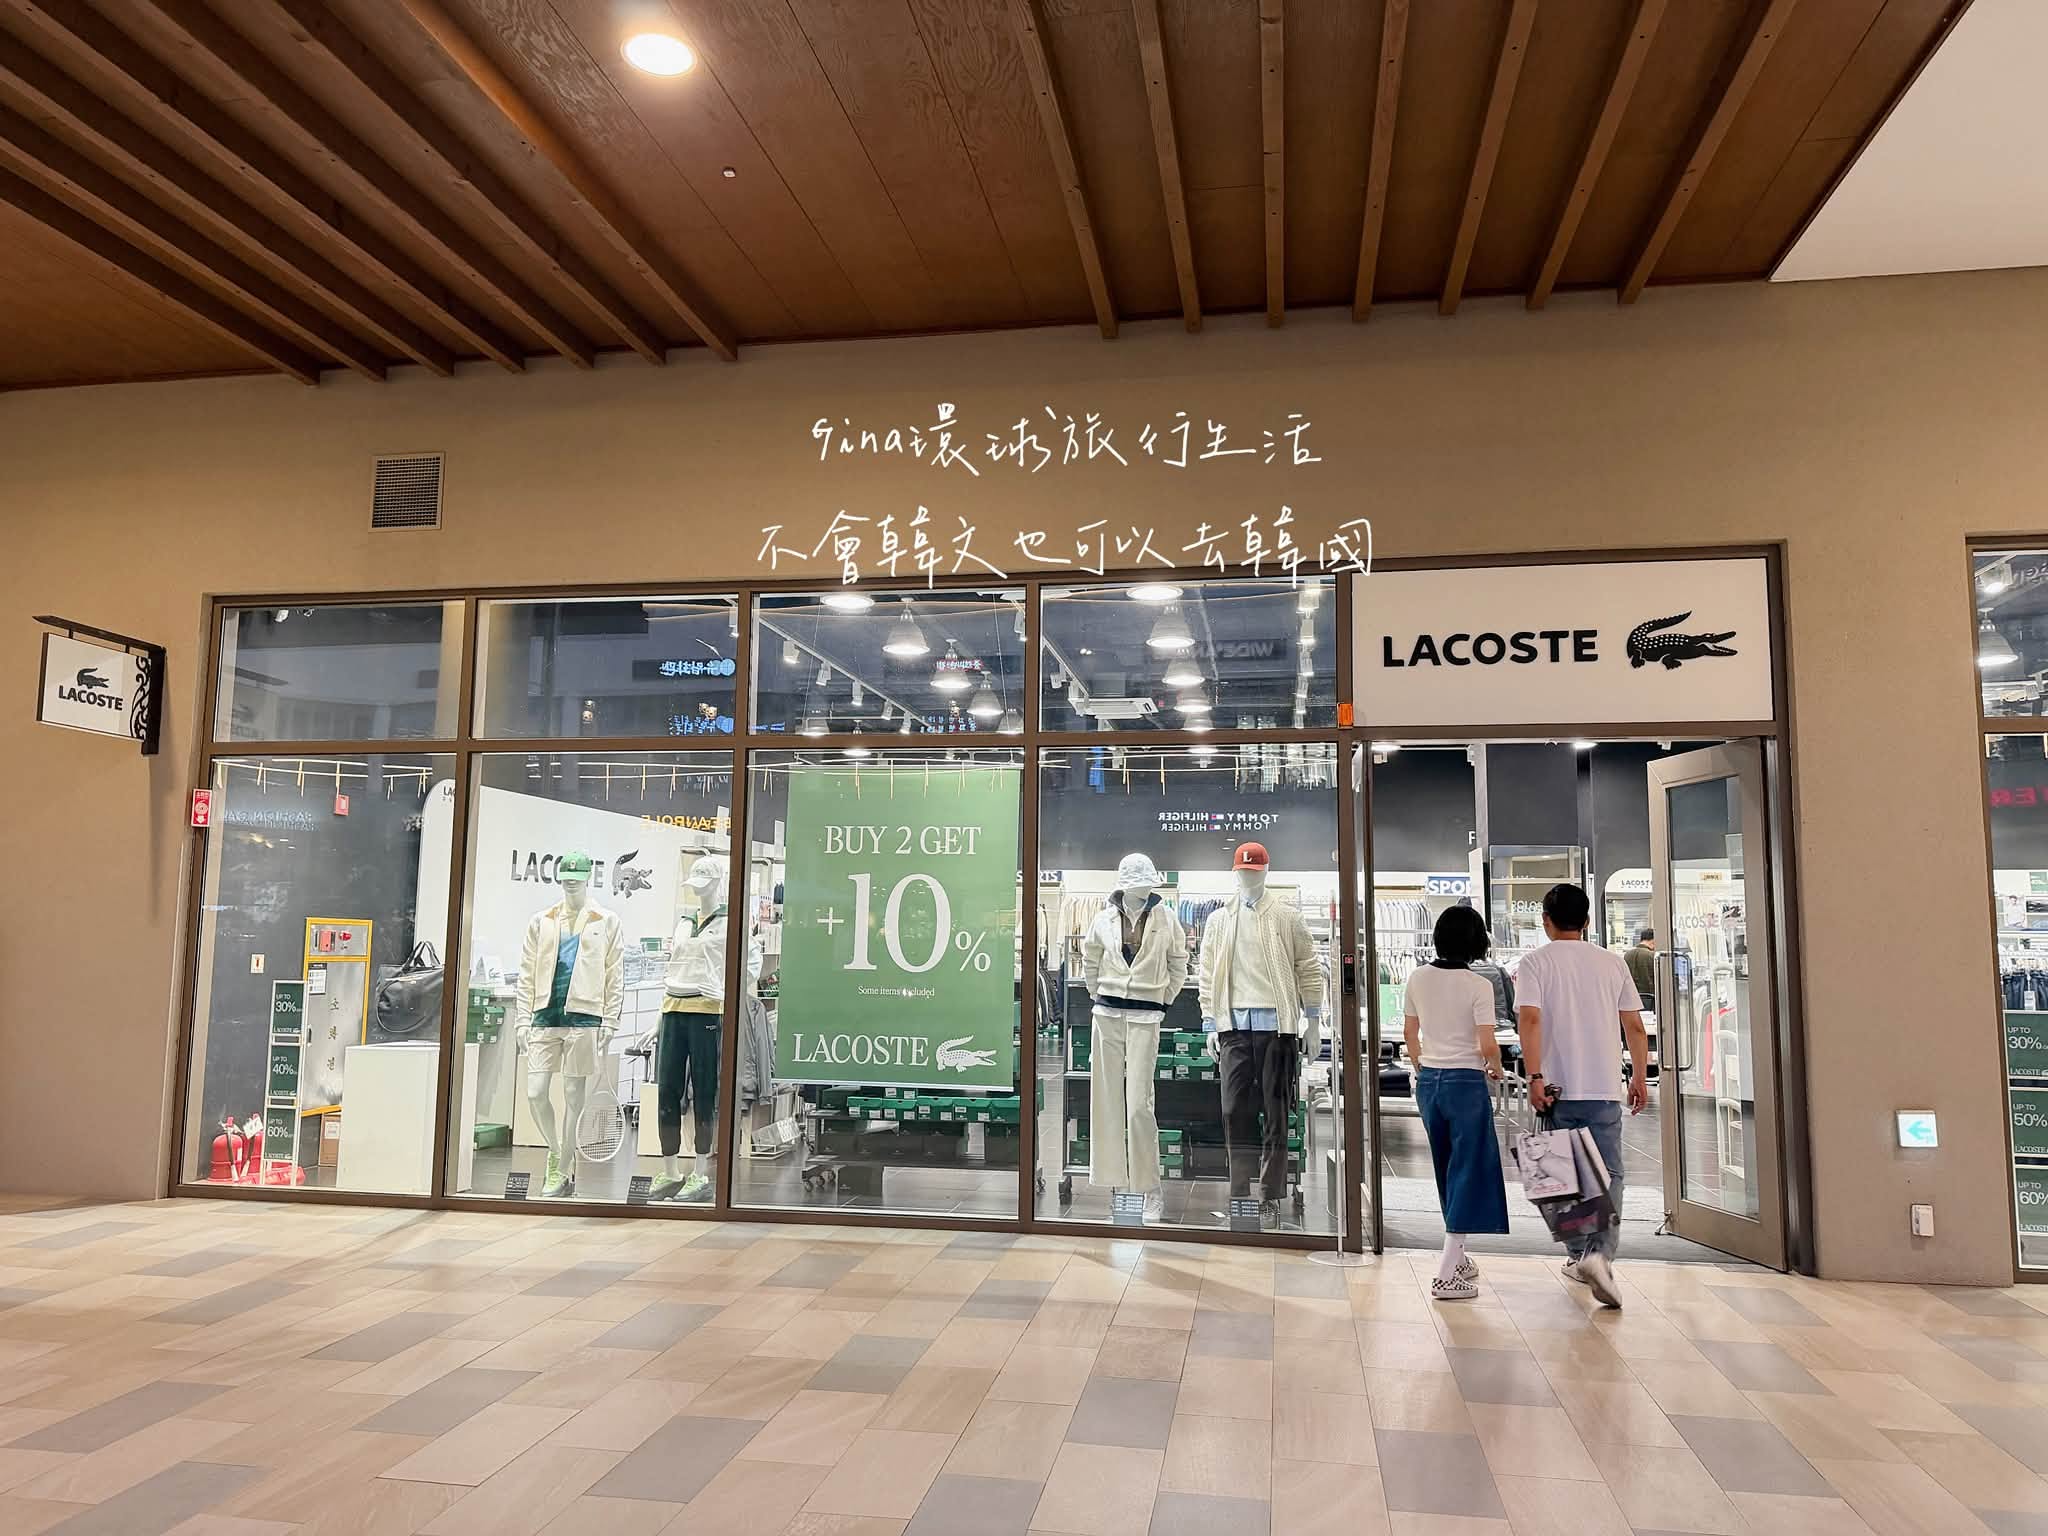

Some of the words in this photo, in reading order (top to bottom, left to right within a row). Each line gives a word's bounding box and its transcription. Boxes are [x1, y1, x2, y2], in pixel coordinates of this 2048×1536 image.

[1383, 629, 1599, 668] LACOSTE
[58, 685, 123, 711] LACOSTE
[824, 825, 888, 854] BUY
[896, 826, 912, 855] 2
[920, 827, 982, 855] GET
[1243, 851, 1252, 862] L
[858, 985, 879, 995] Some
[880, 986, 900, 996] items
[902, 987, 935, 998] cluded
[275, 1001, 296, 1012] 30%
[2008, 1036, 2042, 1049] 30%
[792, 1033, 929, 1066] LACOSTE
[272, 1063, 294, 1075] 40%
[2014, 1113, 2048, 1127] 50%
[267, 1126, 288, 1137] 60%
